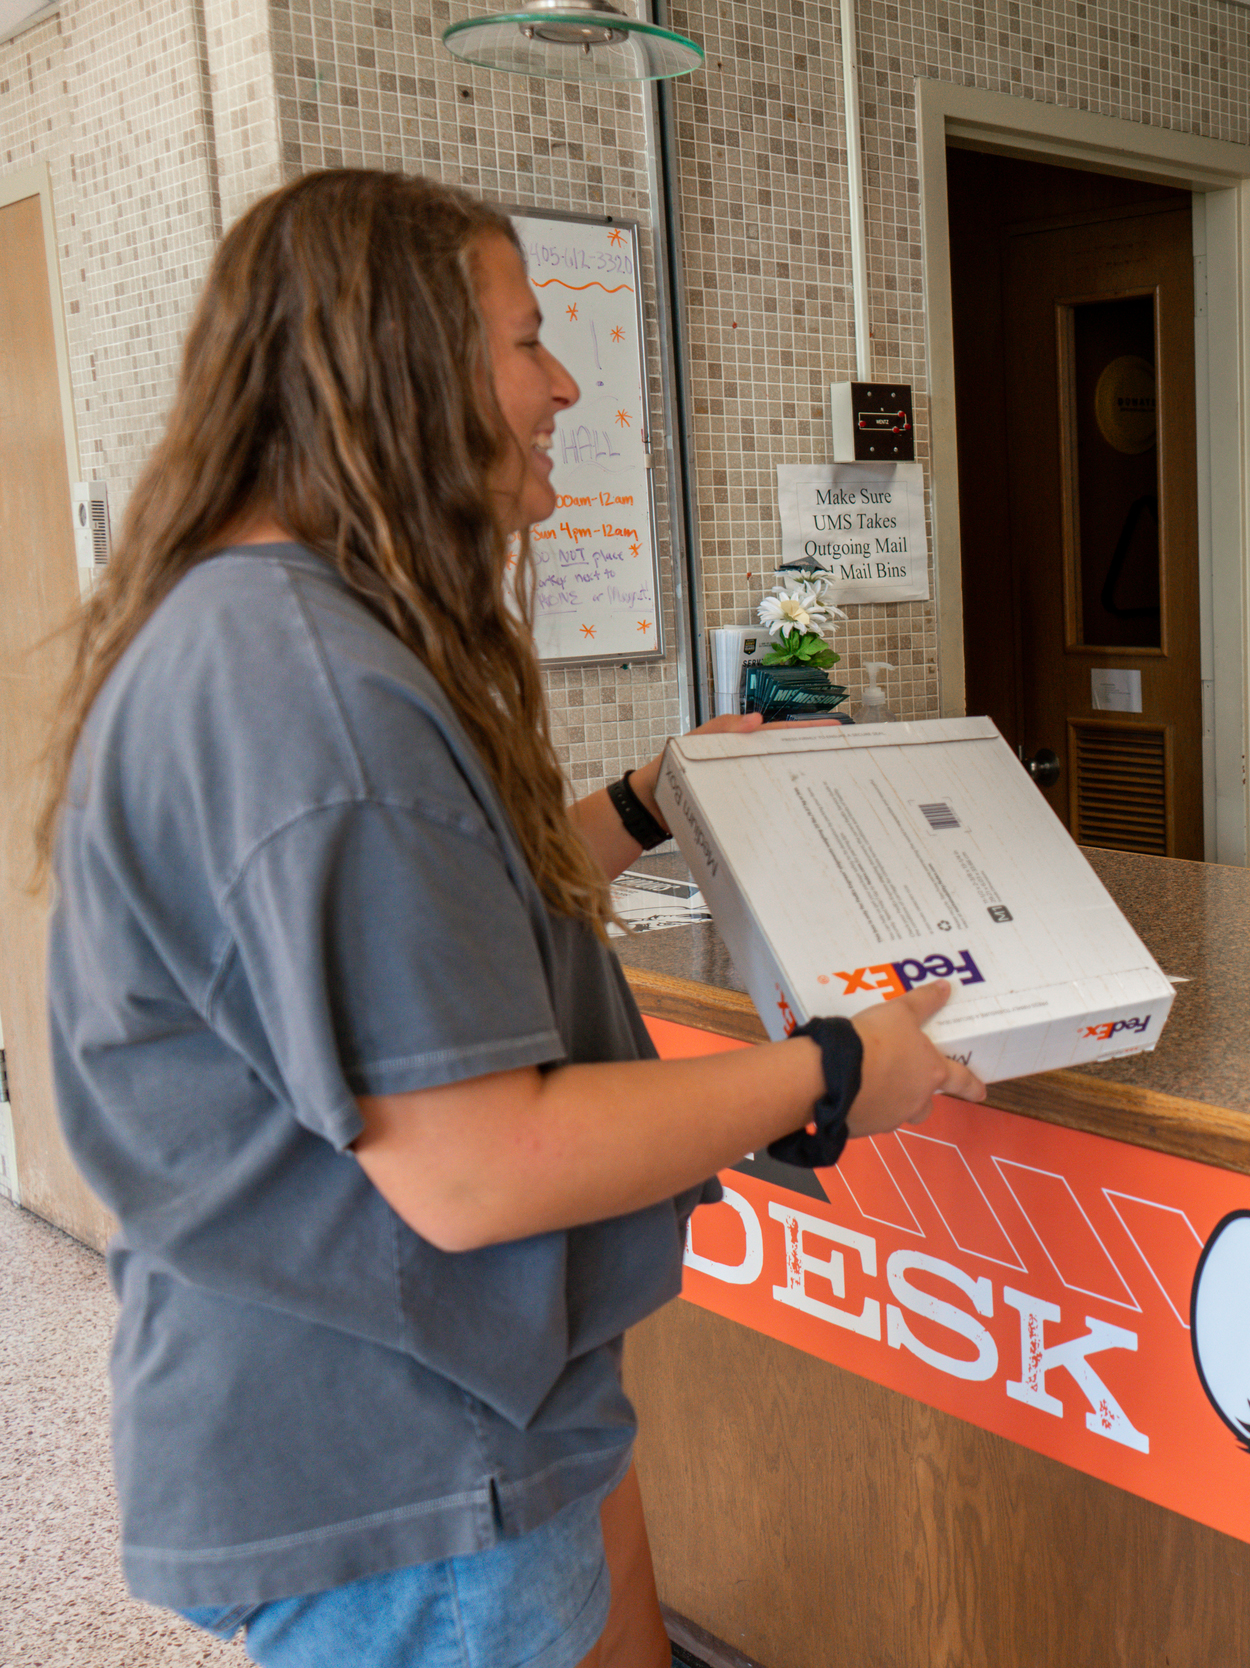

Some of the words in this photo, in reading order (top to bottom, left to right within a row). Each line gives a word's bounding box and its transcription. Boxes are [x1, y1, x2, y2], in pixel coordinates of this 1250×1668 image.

[559, 425, 621, 464] HALL
[815, 488, 856, 505] Make
[860, 488, 892, 504] Sure
[812, 514, 852, 531] UMS
[857, 512, 897, 529] Takes
[559, 548, 587, 563] NOT
[592, 550, 625, 568] place
[804, 538, 872, 560] Outgoing
[875, 536, 907, 553] Mail
[604, 568, 616, 579] to
[840, 562, 873, 580] Mail
[876, 561, 907, 578] Bins
[682, 799, 718, 877] Medium
[991, 906, 1009, 920] M1
[832, 949, 986, 1001] FedEx
[1082, 1014, 1152, 1041] FedEx
[682, 1186, 1150, 1454] DESK
